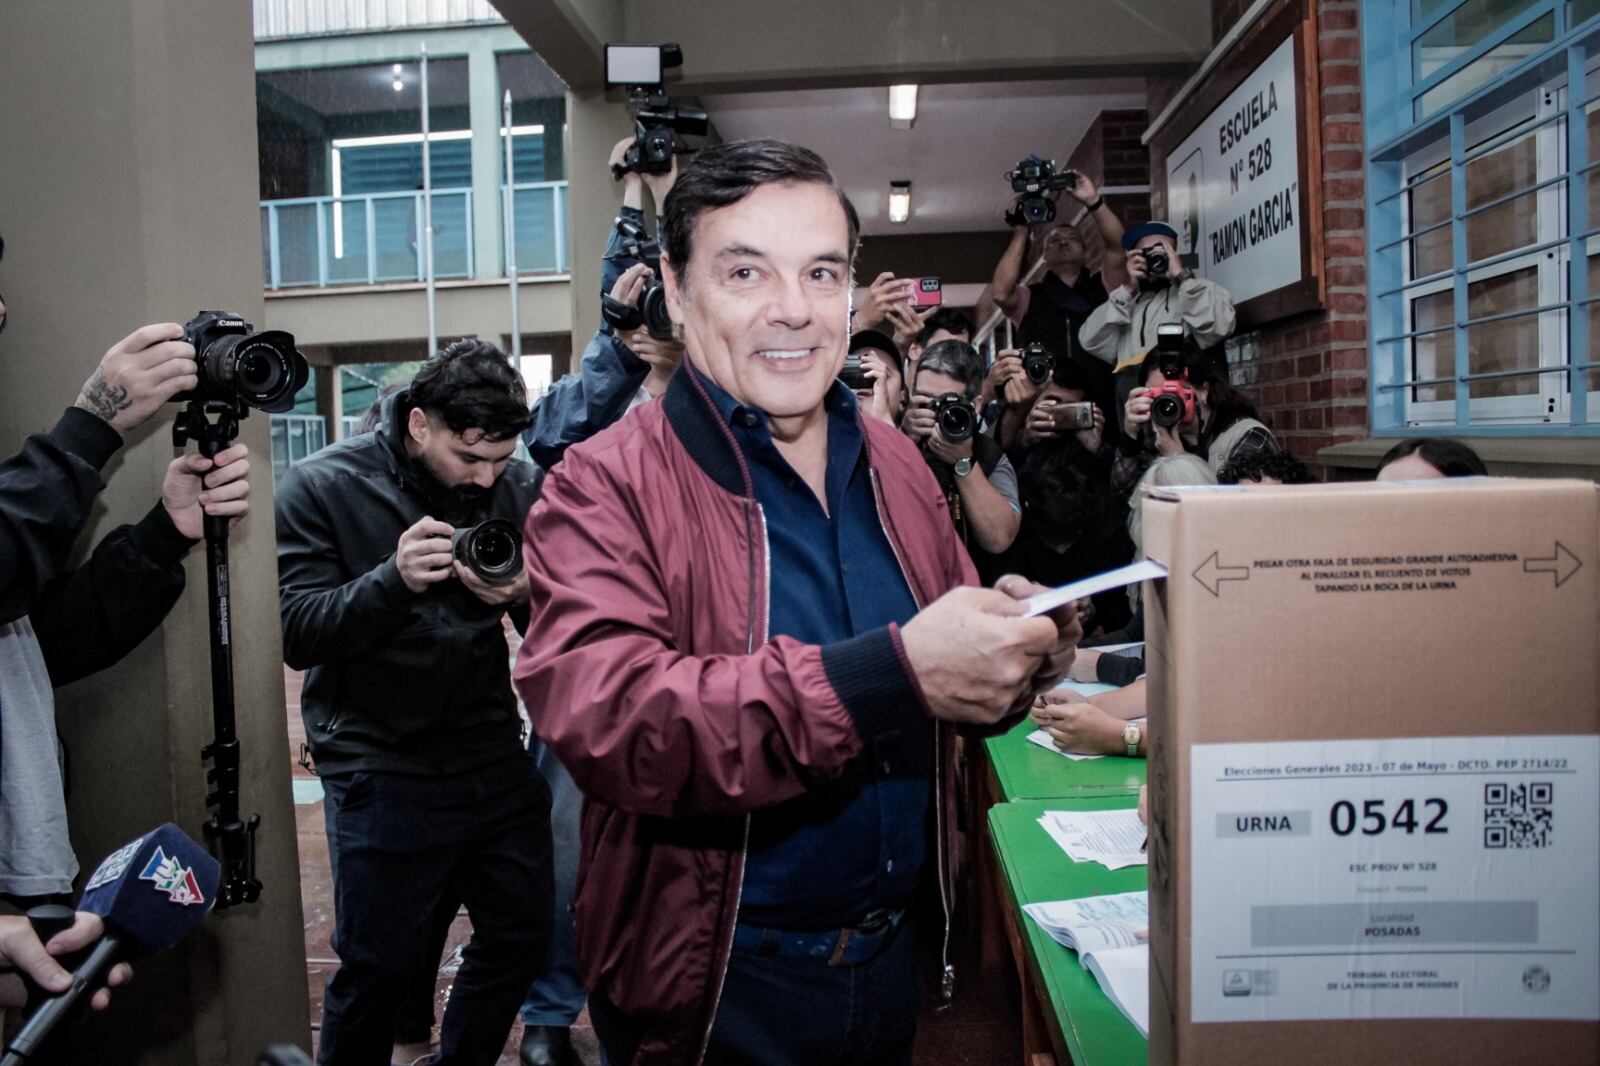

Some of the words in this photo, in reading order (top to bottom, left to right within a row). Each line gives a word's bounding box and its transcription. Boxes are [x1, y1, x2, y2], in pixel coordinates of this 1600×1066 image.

[1219, 80, 1278, 155] ESCUELA
[1249, 137, 1272, 182] 528
[219, 319, 244, 327] Canon
[1254, 560, 1283, 569] PEGAR
[1286, 559, 1311, 568] OTRA
[1314, 558, 1336, 567] FAJA
[1337, 558, 1348, 566] DE
[1351, 556, 1403, 566] SEGURIDAD
[1406, 555, 1444, 564] GRANDE
[1447, 553, 1517, 563] AUTOADHESIVA
[1301, 572, 1312, 580] AL
[1314, 570, 1360, 579] FINALIZAR
[1363, 570, 1373, 578] EL
[1375, 569, 1423, 578] RECUENTO
[1425, 568, 1437, 577] DE
[1440, 567, 1471, 576] VOTOS
[1315, 584, 1358, 593] TAPANDO
[1360, 584, 1372, 592] LA
[1374, 582, 1399, 591] BOCA
[1402, 582, 1413, 591] DE
[1416, 582, 1427, 590] LA
[1430, 581, 1456, 590] URNA
[1224, 766, 1281, 777] Elecciones
[1285, 764, 1341, 775] Generales
[1345, 763, 1372, 773] 2023
[1382, 761, 1396, 772] 07
[1400, 761, 1413, 771] de
[1417, 760, 1447, 773] Mayo
[1496, 759, 1518, 769] PEP
[1522, 758, 1567, 769] 2714/22
[1329, 798, 1449, 836] 0542
[1236, 816, 1292, 833] URNA
[1349, 864, 1368, 873] ESC
[1371, 863, 1400, 872] PROV
[1418, 862, 1436, 871] 528
[1370, 912, 1415, 922] Localidad
[1364, 926, 1421, 937] POSADAS
[1346, 971, 1388, 979] TRIBUNAL
[1391, 970, 1438, 979] ELECTORAL
